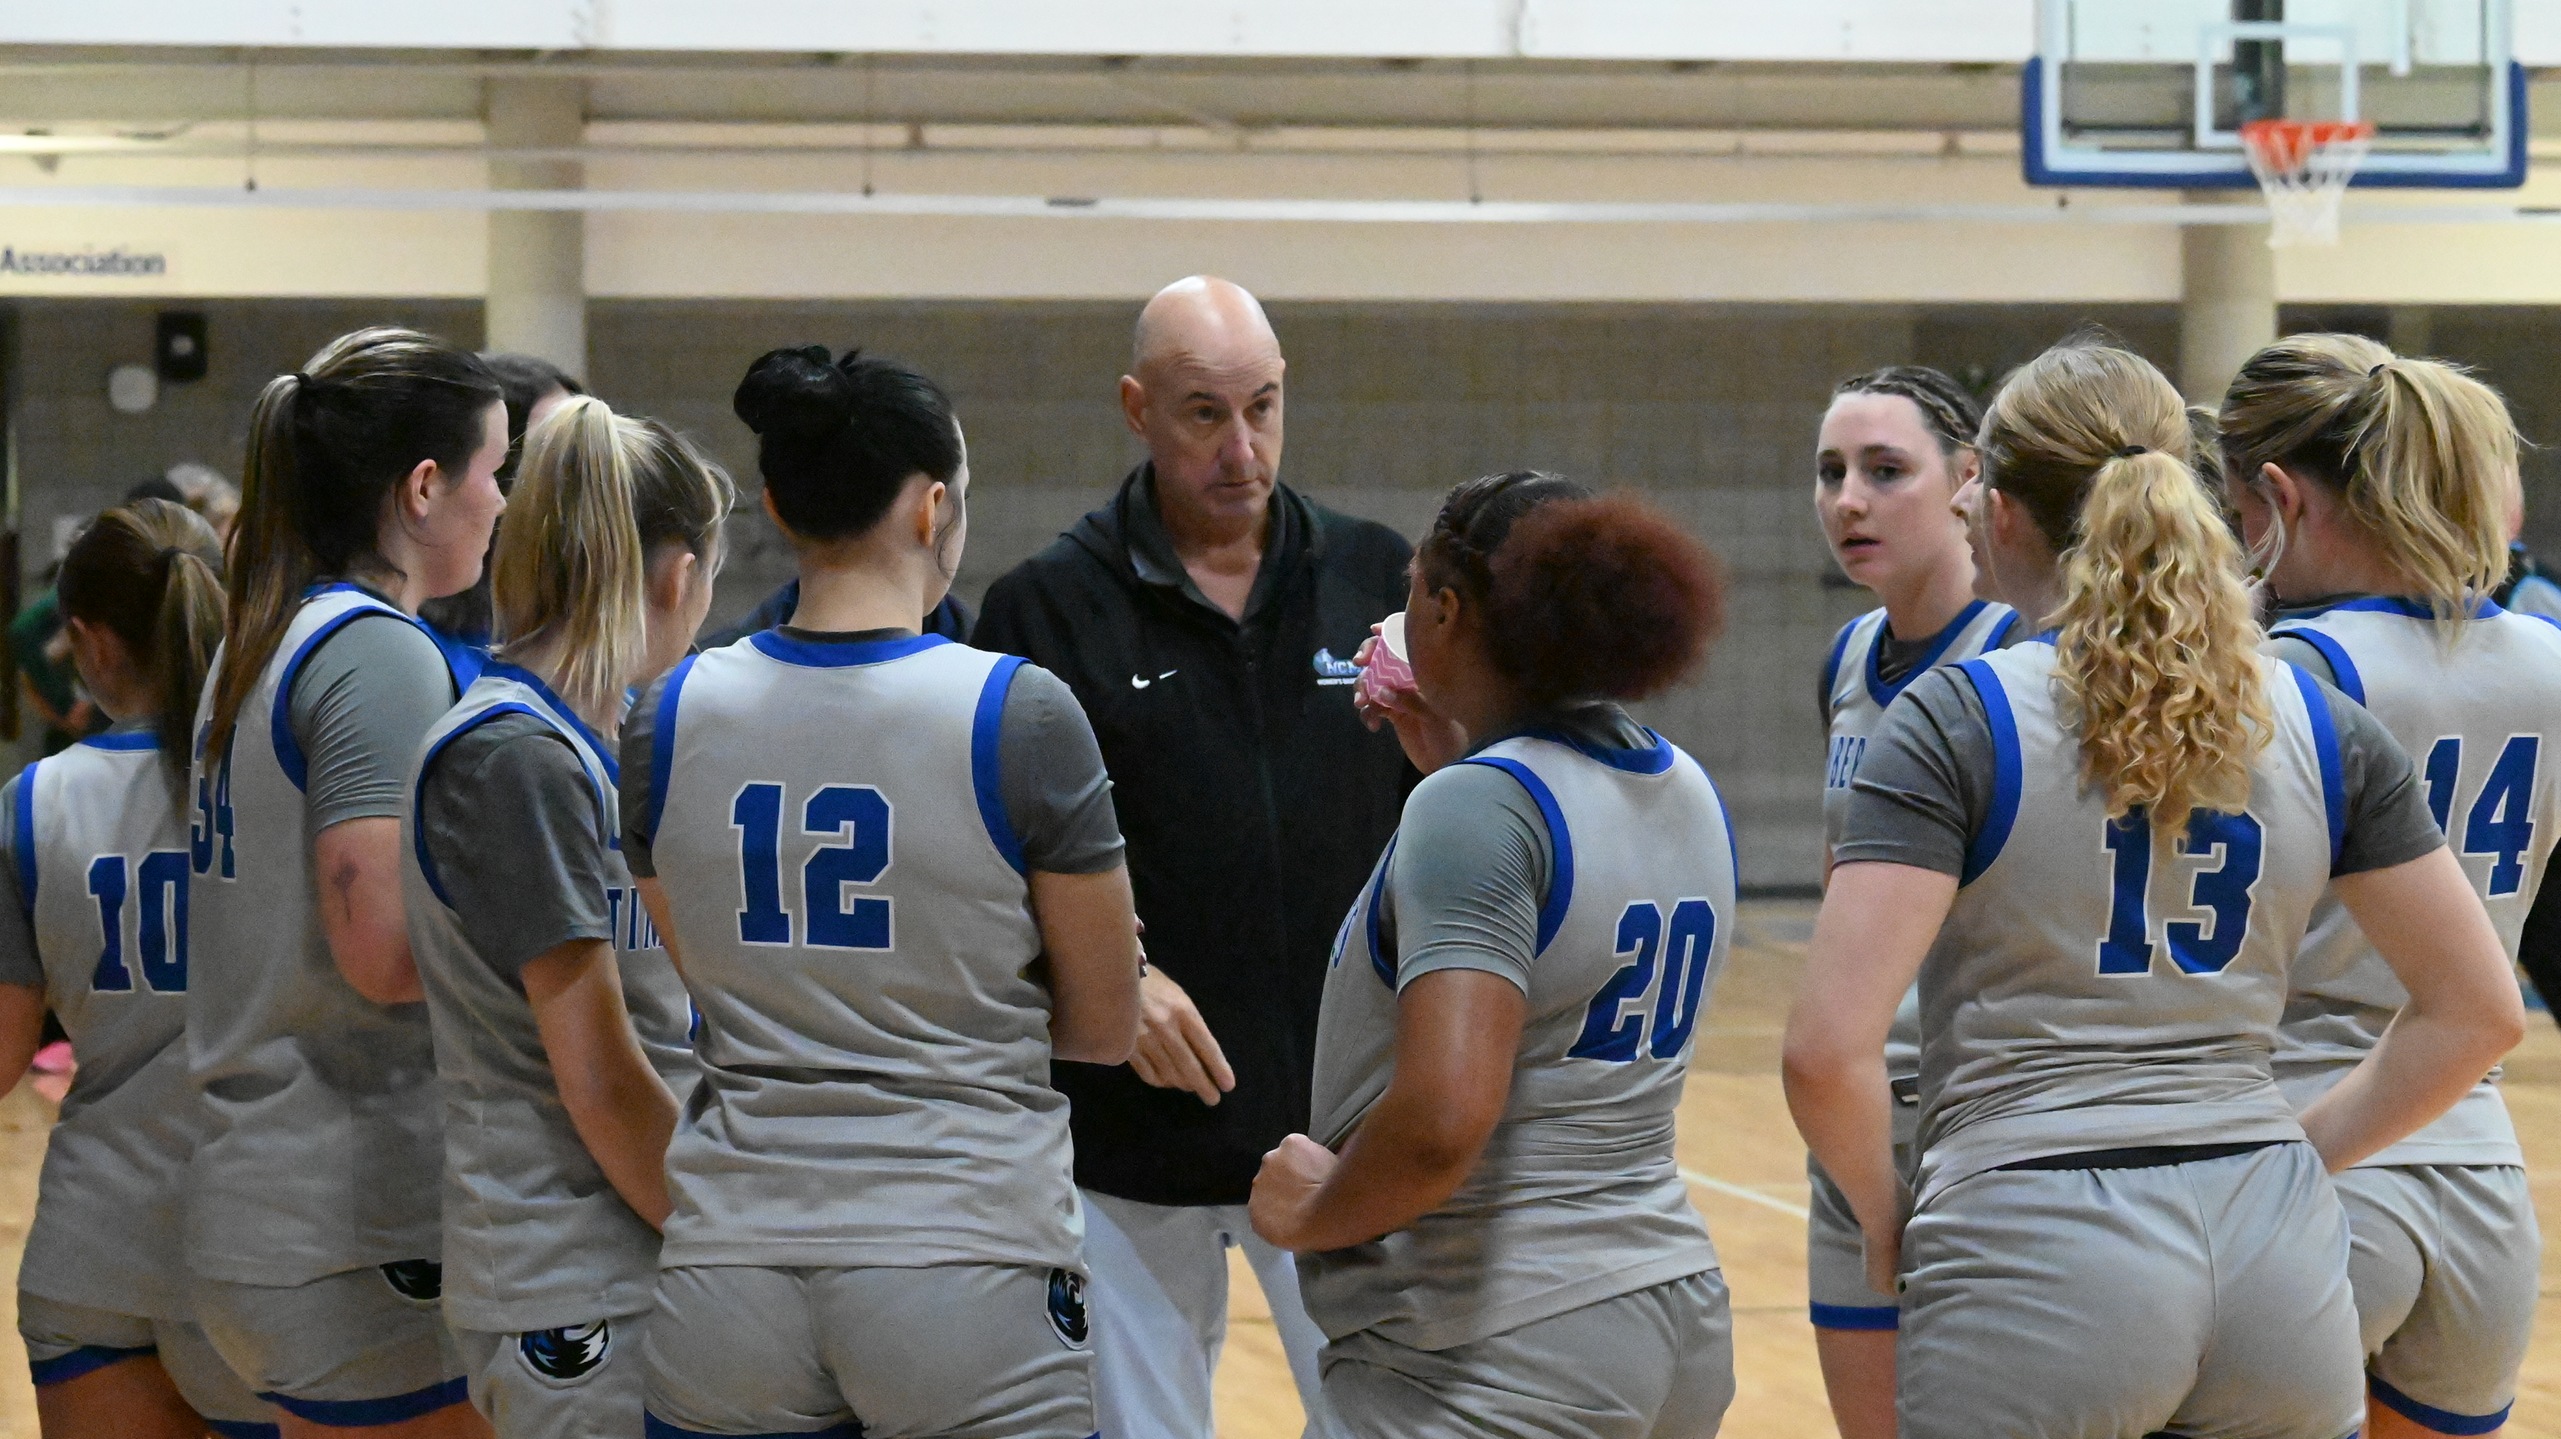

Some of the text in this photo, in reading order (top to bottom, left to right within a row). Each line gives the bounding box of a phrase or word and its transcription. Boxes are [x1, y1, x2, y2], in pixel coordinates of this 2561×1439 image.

[0, 245, 166, 277] Association
[729, 779, 895, 953] 12
[2095, 805, 2266, 978] 13
[2424, 731, 2543, 900] 14
[86, 850, 190, 995] 10
[1564, 896, 1716, 1063] 20
